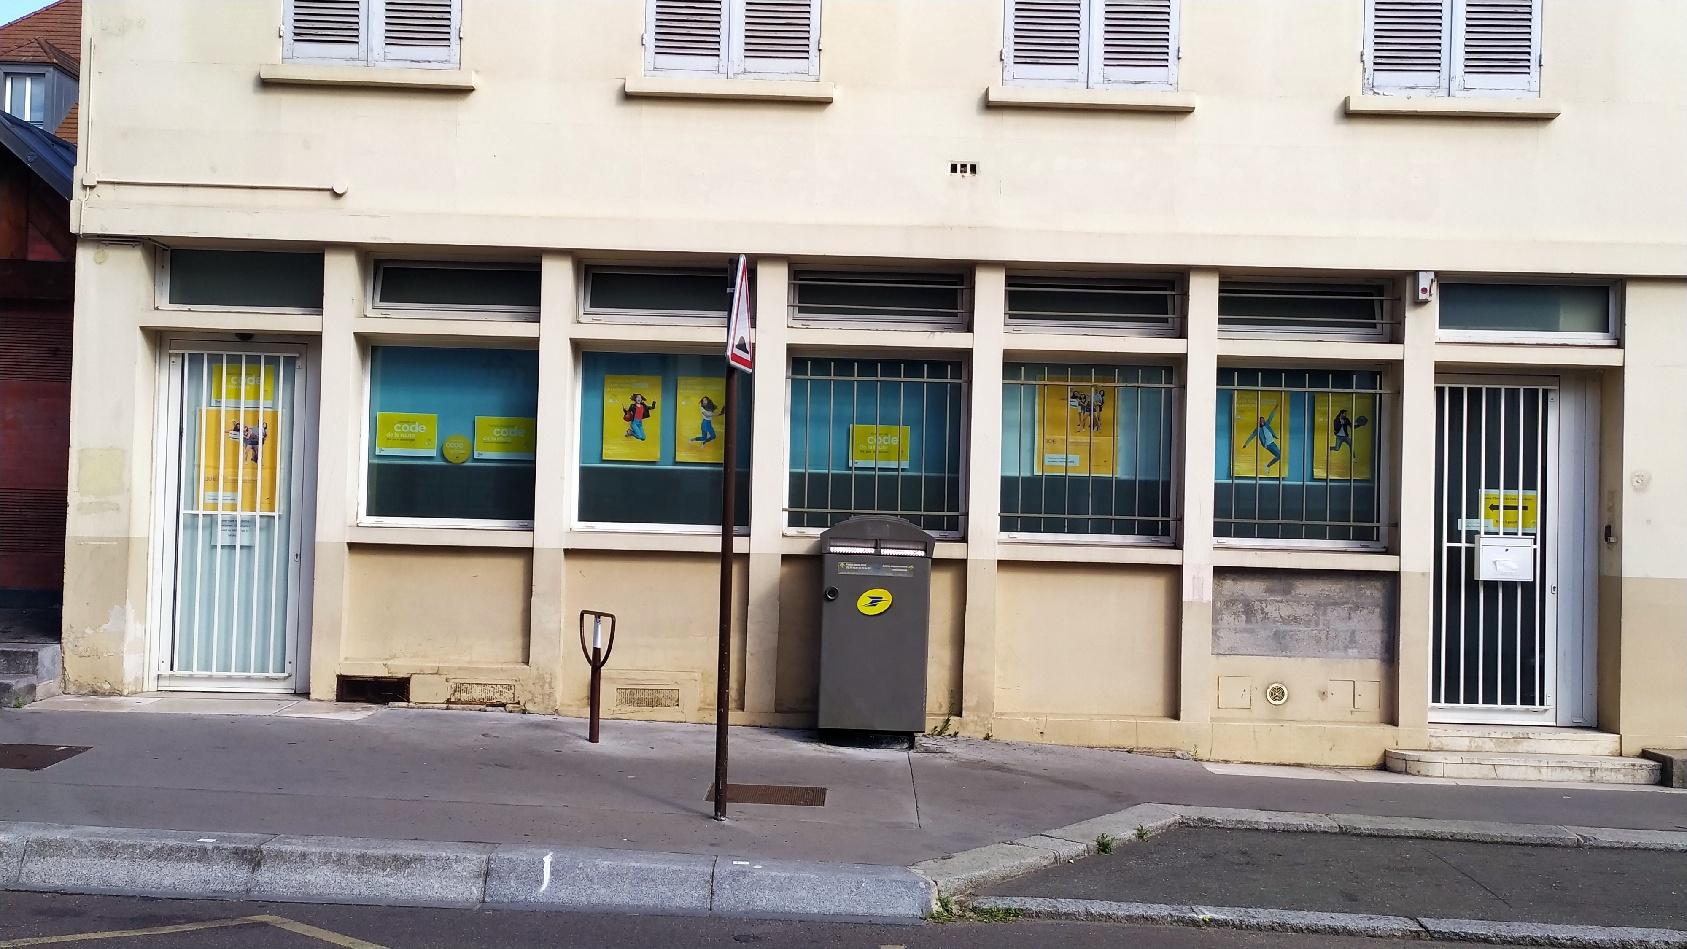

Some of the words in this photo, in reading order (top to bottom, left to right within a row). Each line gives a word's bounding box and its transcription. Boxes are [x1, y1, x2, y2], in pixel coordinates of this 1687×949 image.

[231, 374, 263, 385] cde
[394, 421, 426, 432] code
[493, 426, 526, 437] code
